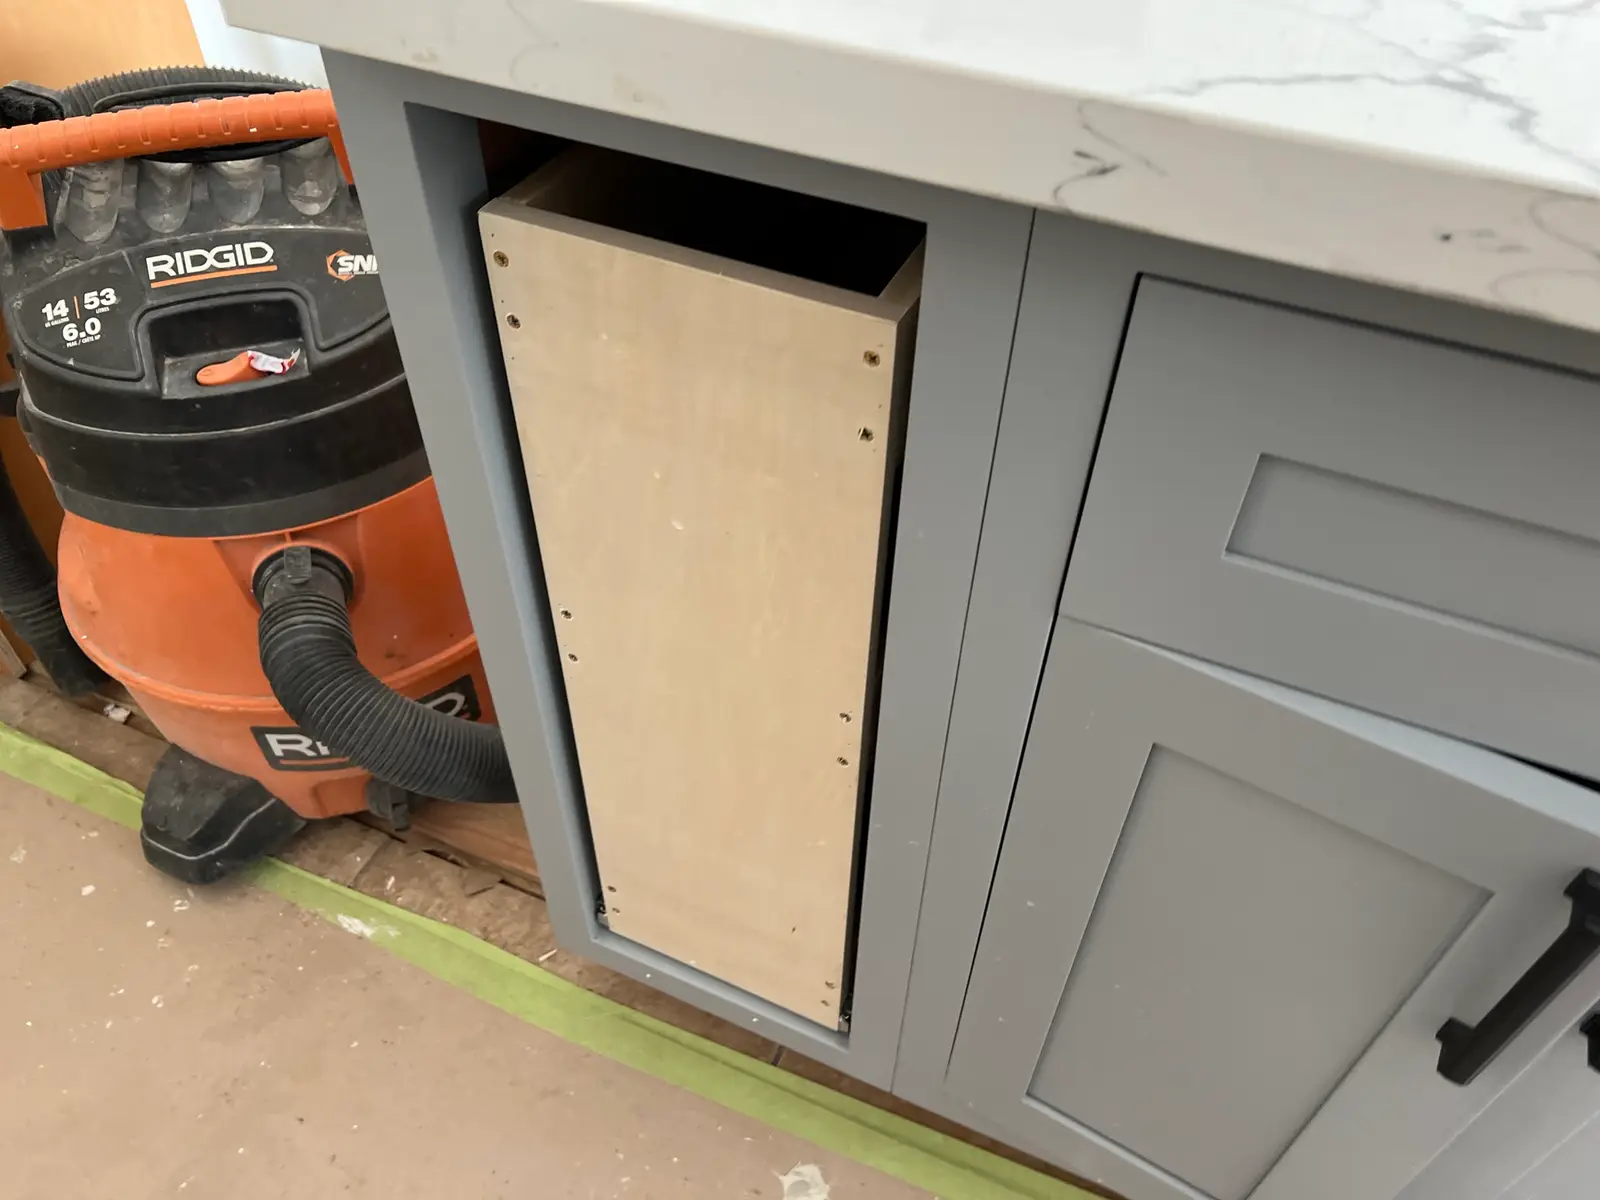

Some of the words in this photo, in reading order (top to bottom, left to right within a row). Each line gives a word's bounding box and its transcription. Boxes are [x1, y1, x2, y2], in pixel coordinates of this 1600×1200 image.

[145, 241, 274, 280] RIDGID
[41, 299, 69, 321] 14
[83, 287, 117, 310] 53
[62, 317, 101, 342] 6.0
